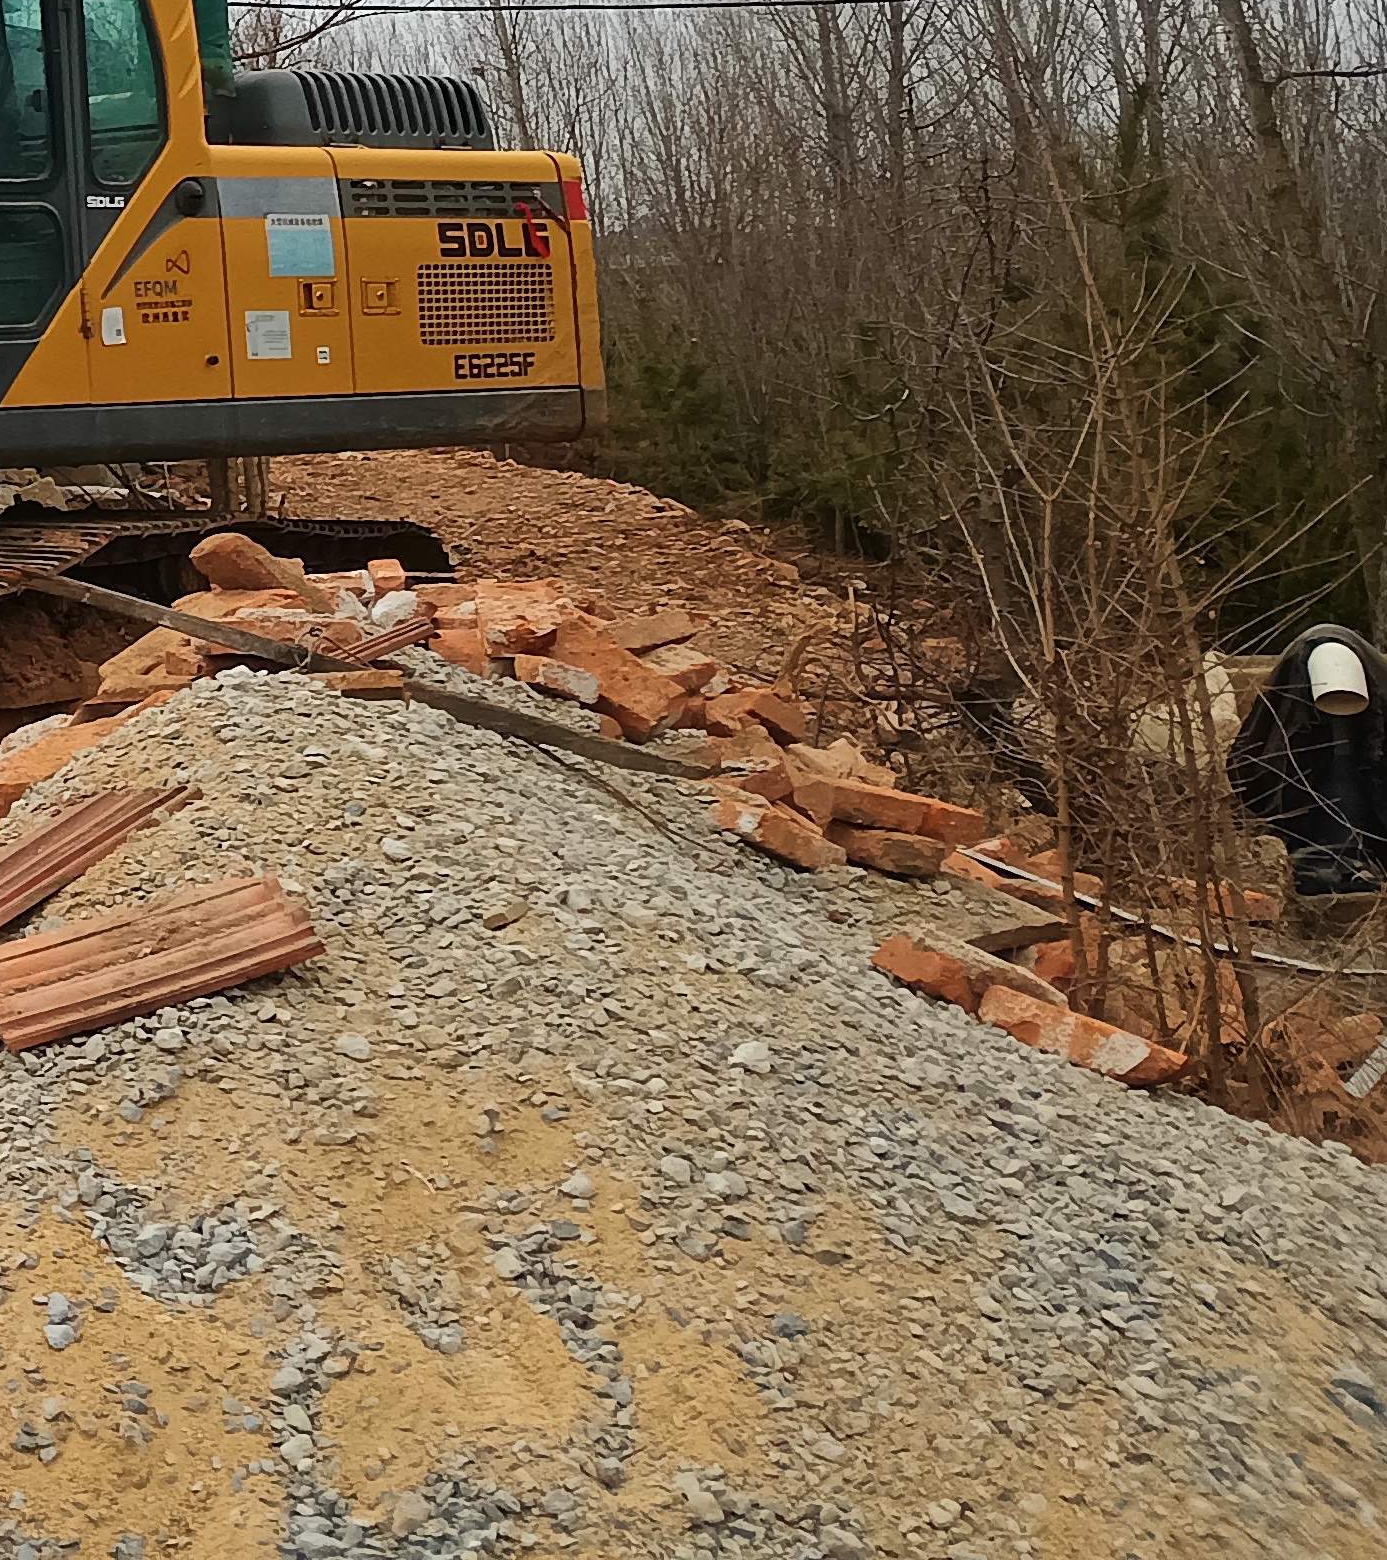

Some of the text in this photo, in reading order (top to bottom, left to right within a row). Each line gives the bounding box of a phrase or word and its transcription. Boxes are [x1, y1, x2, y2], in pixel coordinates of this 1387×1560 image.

[86, 195, 125, 208] SDLG
[133, 280, 178, 298] EFQM
[453, 351, 536, 380] E6225F
